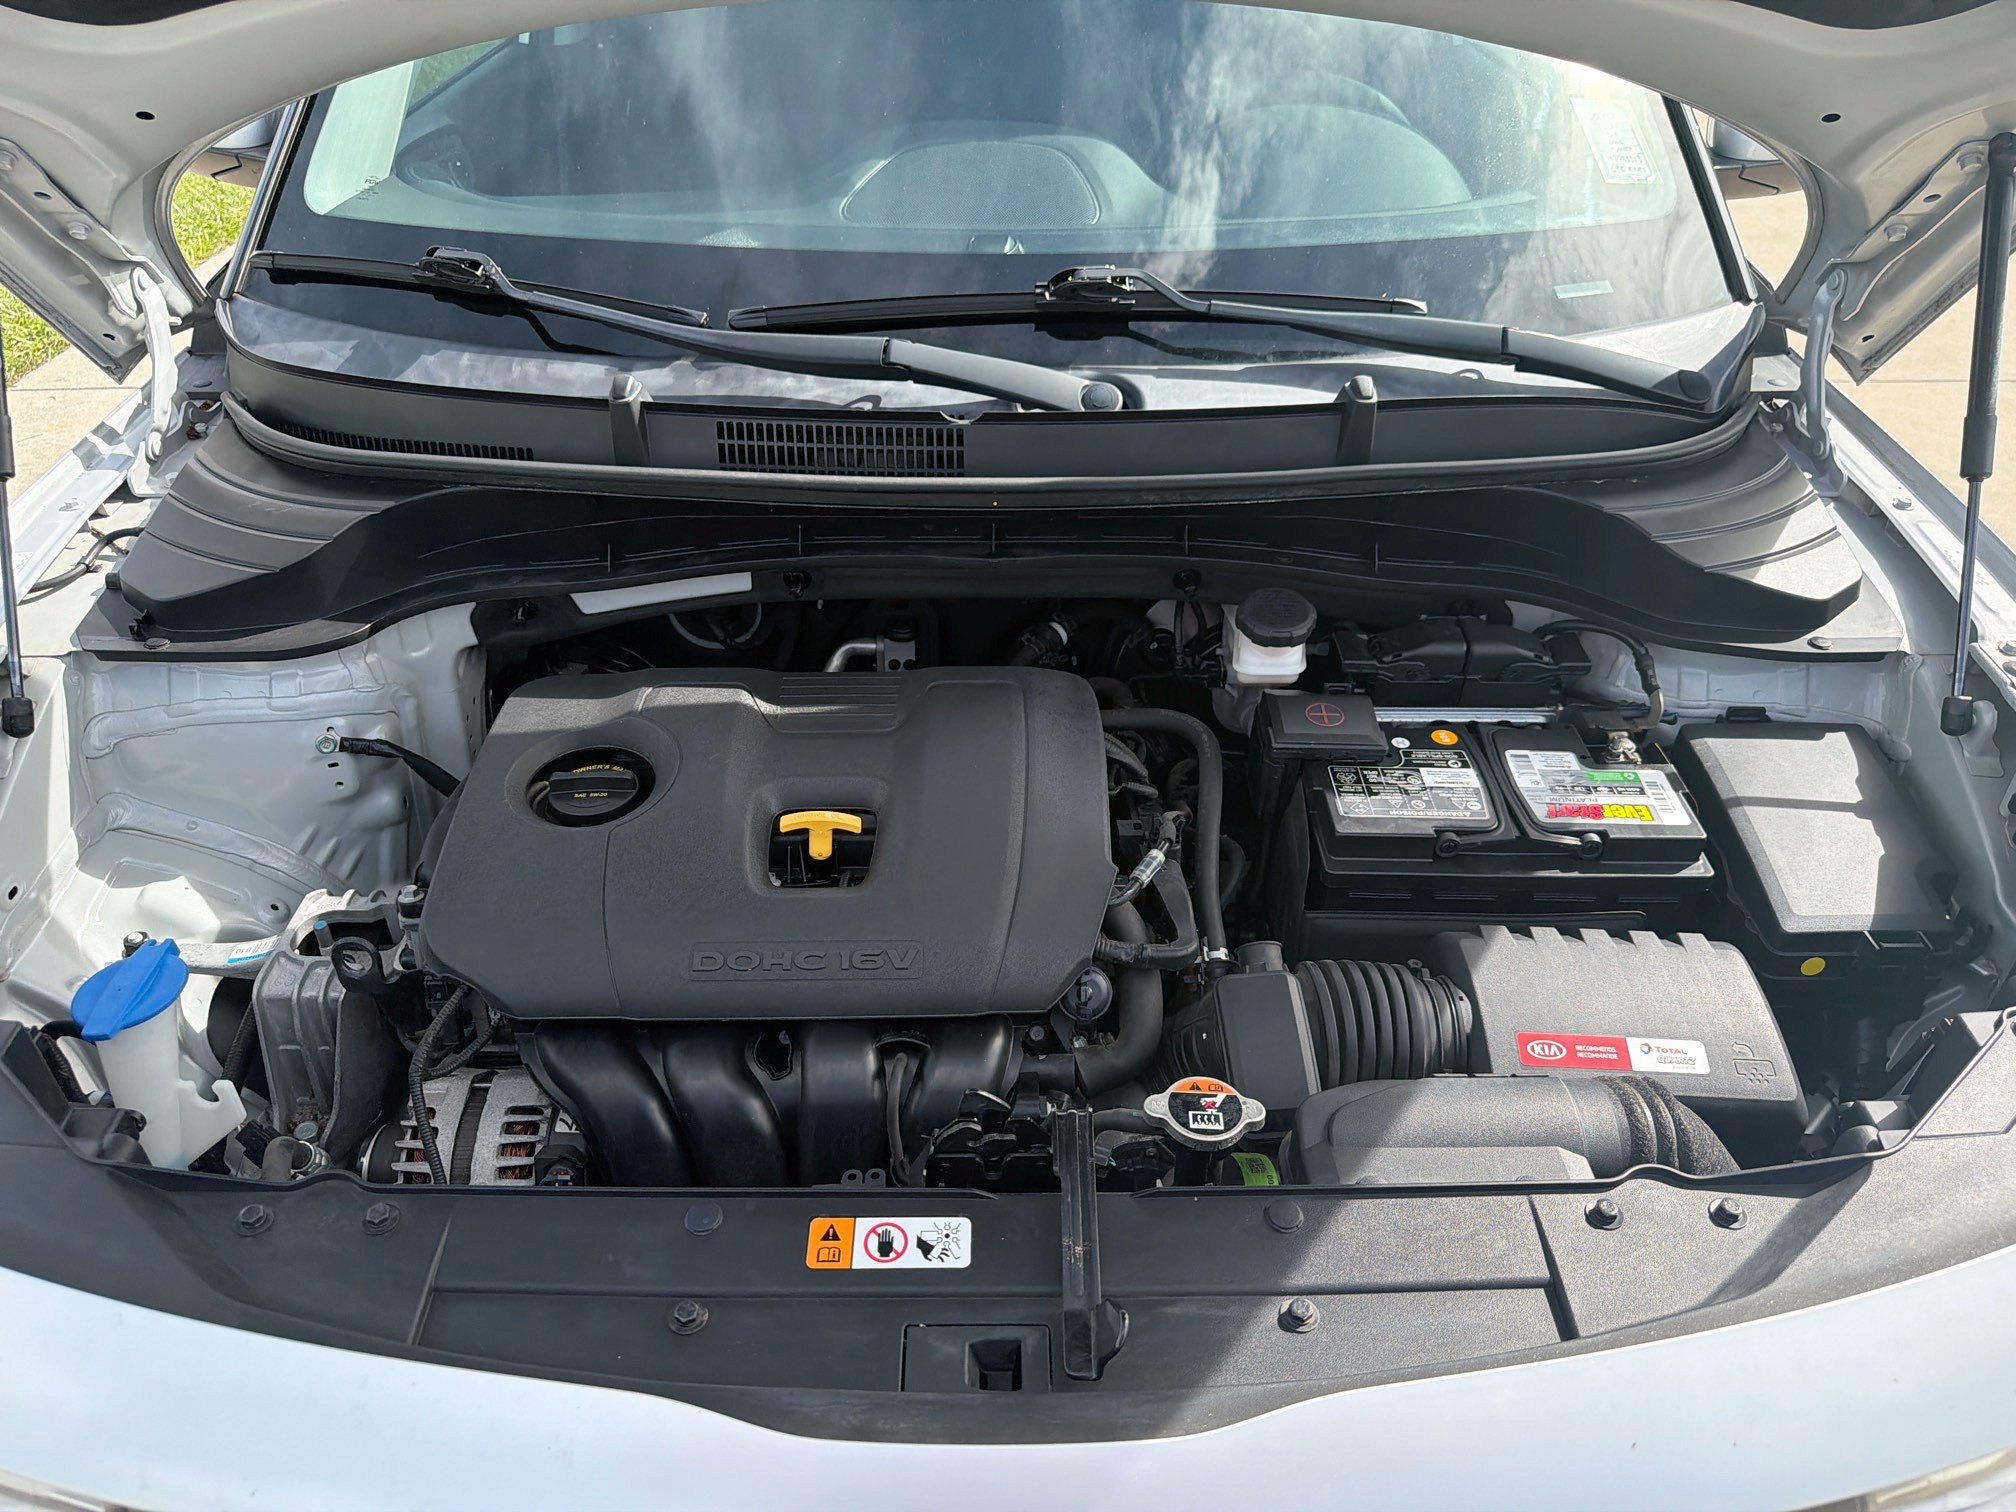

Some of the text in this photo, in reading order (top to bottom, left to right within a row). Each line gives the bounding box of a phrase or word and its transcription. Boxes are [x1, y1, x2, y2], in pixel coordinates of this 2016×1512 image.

[1546, 802, 1656, 822] EverStart
[692, 947, 920, 972] DOHC 16V
[1533, 1043, 1562, 1057] KIA
[1652, 1045, 1688, 1056] TOTAL
[1657, 1054, 1697, 1066] QUARTZ
